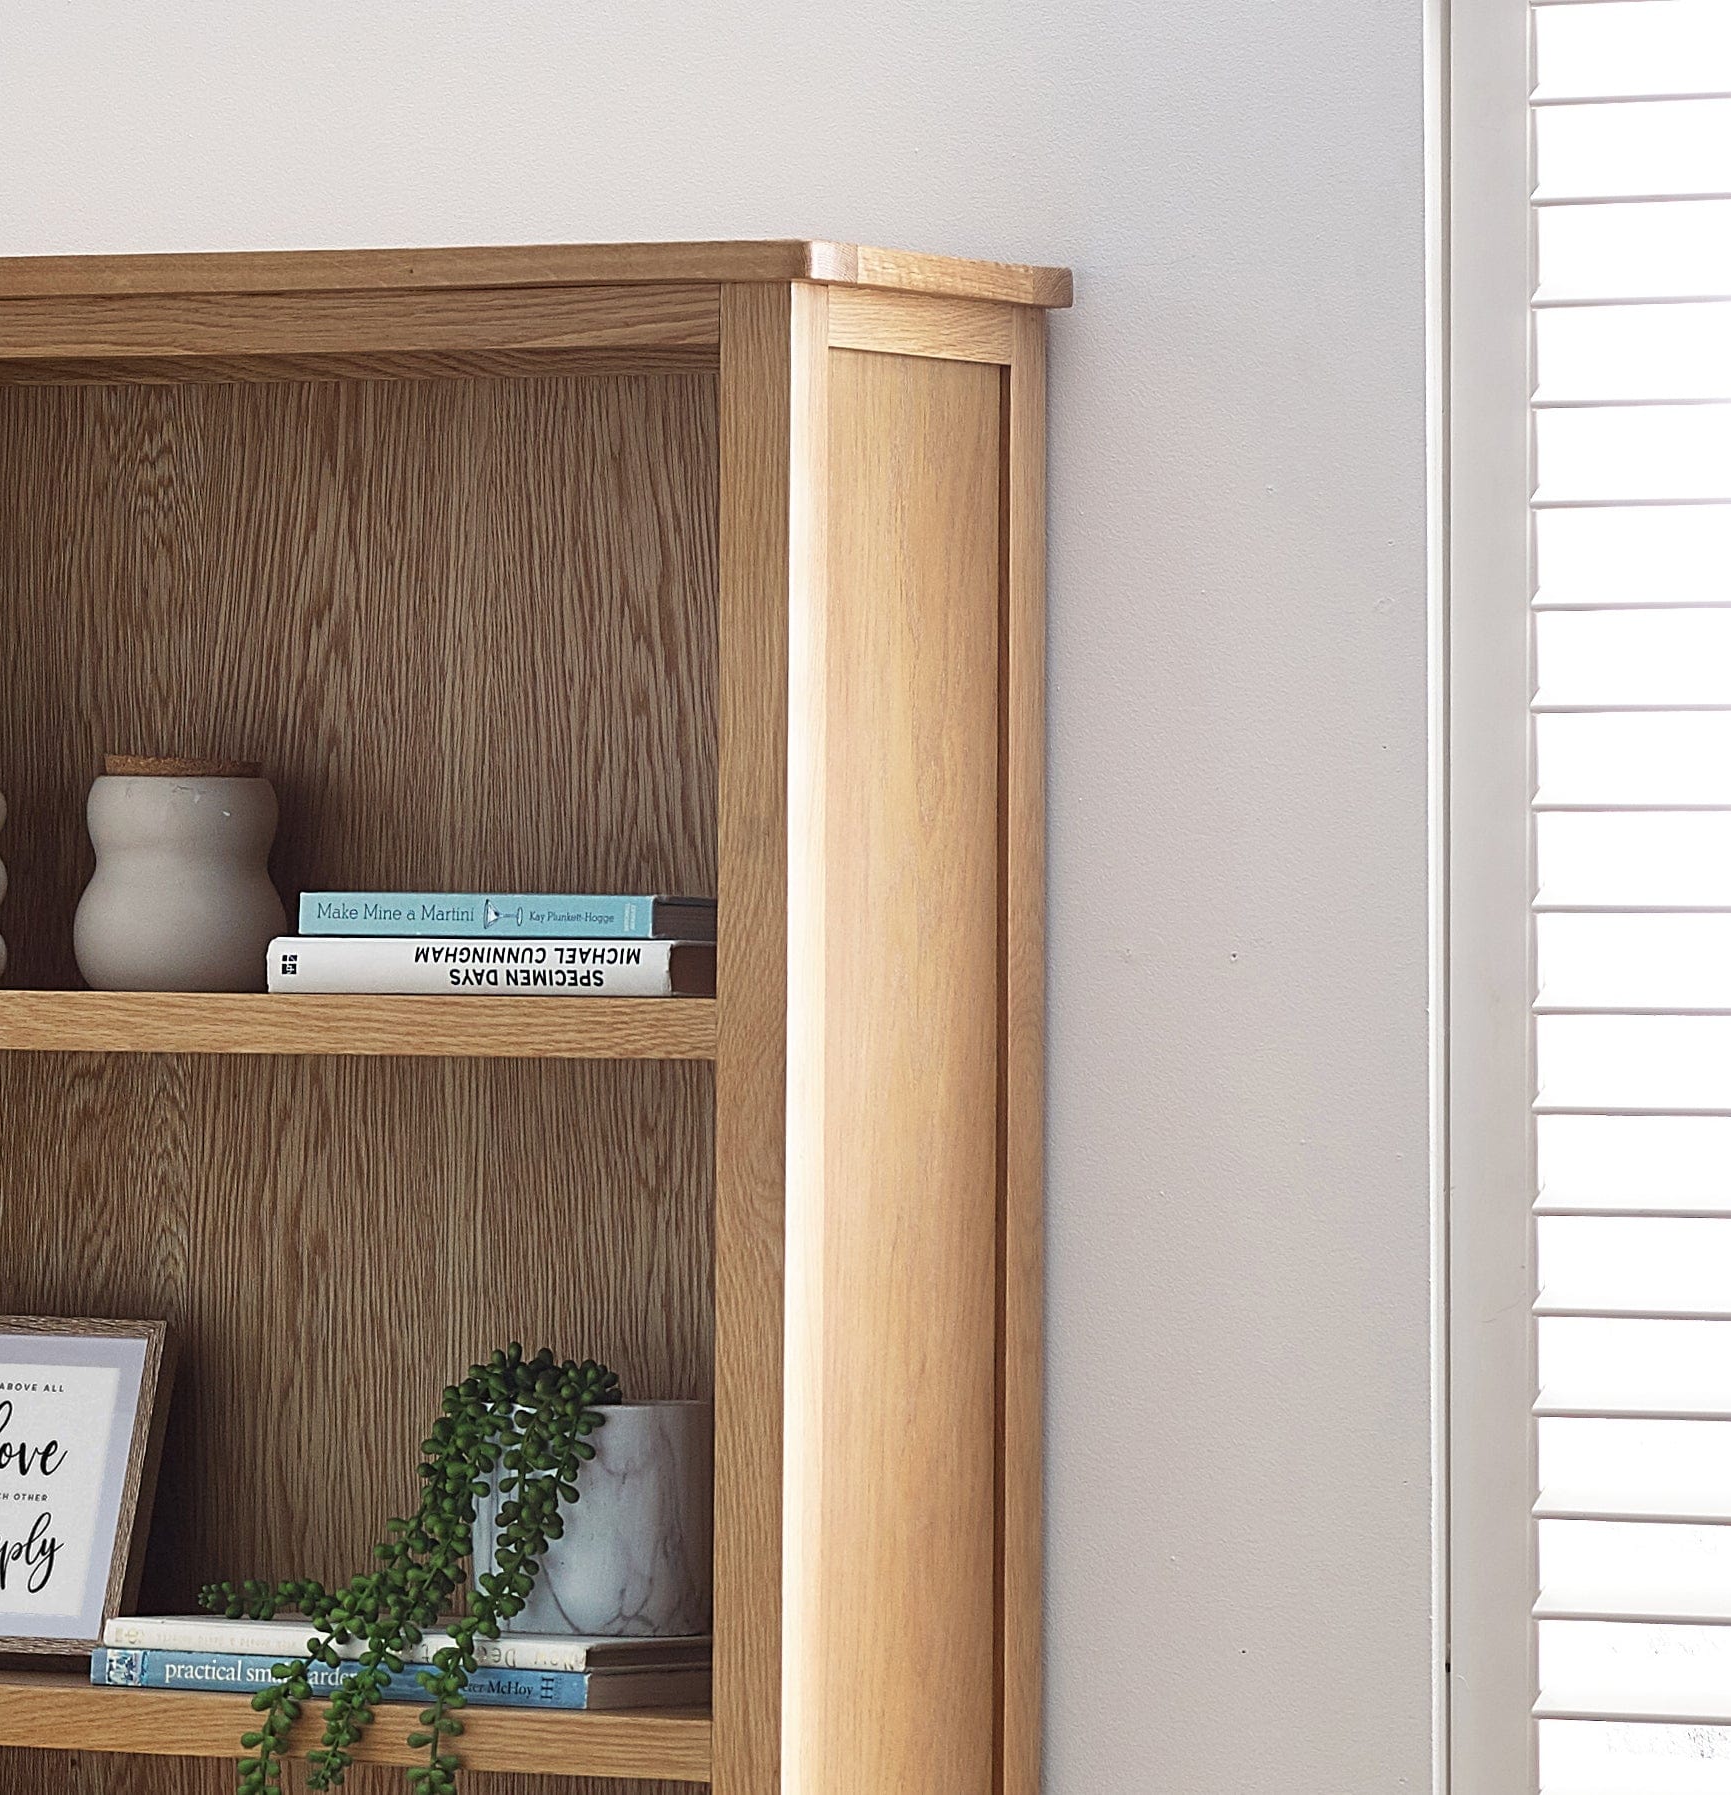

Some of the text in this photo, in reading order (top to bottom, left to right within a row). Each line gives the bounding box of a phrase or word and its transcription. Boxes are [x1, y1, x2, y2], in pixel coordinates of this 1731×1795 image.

[316, 902, 475, 922] Make Mine a Martini
[529, 911, 545, 923] Kay
[414, 946, 641, 965] MICHAEL CUNNINGHAM
[449, 968, 604, 987] SPECIMEN DAYS
[43, 1384, 65, 1393] ALL
[13, 1493, 48, 1502] OTHER
[165, 1659, 241, 1682] practical
[309, 1666, 358, 1686] arde
[463, 1682, 484, 1693] eter
[486, 1680, 534, 1699] McHoy
